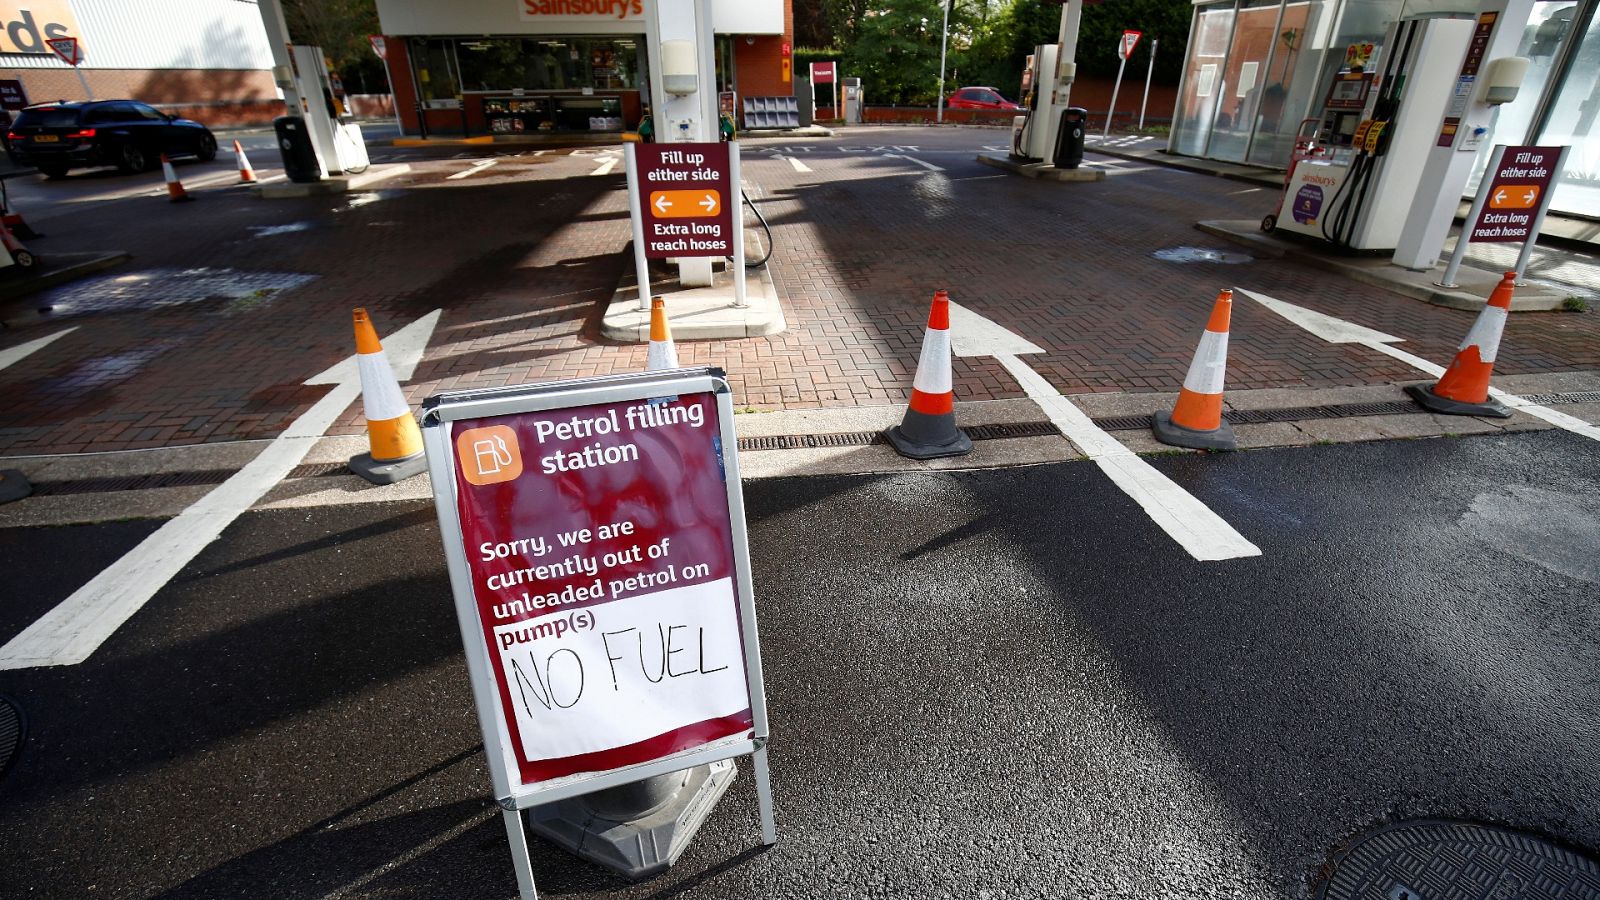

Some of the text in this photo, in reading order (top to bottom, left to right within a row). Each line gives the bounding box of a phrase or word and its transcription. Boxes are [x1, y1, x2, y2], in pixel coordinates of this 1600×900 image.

[525, 0, 643, 19] Sainsburys
[0, 9, 79, 54] ds
[661, 151, 704, 166] Fill up
[1515, 152, 1544, 166] Fill up
[648, 168, 720, 181] either side
[1500, 167, 1547, 178] either side
[654, 222, 721, 236] Extra long
[1483, 213, 1529, 226] Extra long
[1474, 226, 1528, 237] reach hoses
[651, 238, 726, 251] reach hoses
[534, 402, 705, 444] Petrol filling
[541, 440, 639, 475] station
[480, 520, 634, 562] Sorry, we are
[486, 538, 670, 591] currently out of
[493, 562, 710, 619] unleaded petrol on
[499, 610, 597, 650] pump(s)
[511, 622, 729, 719] NO FUEL
